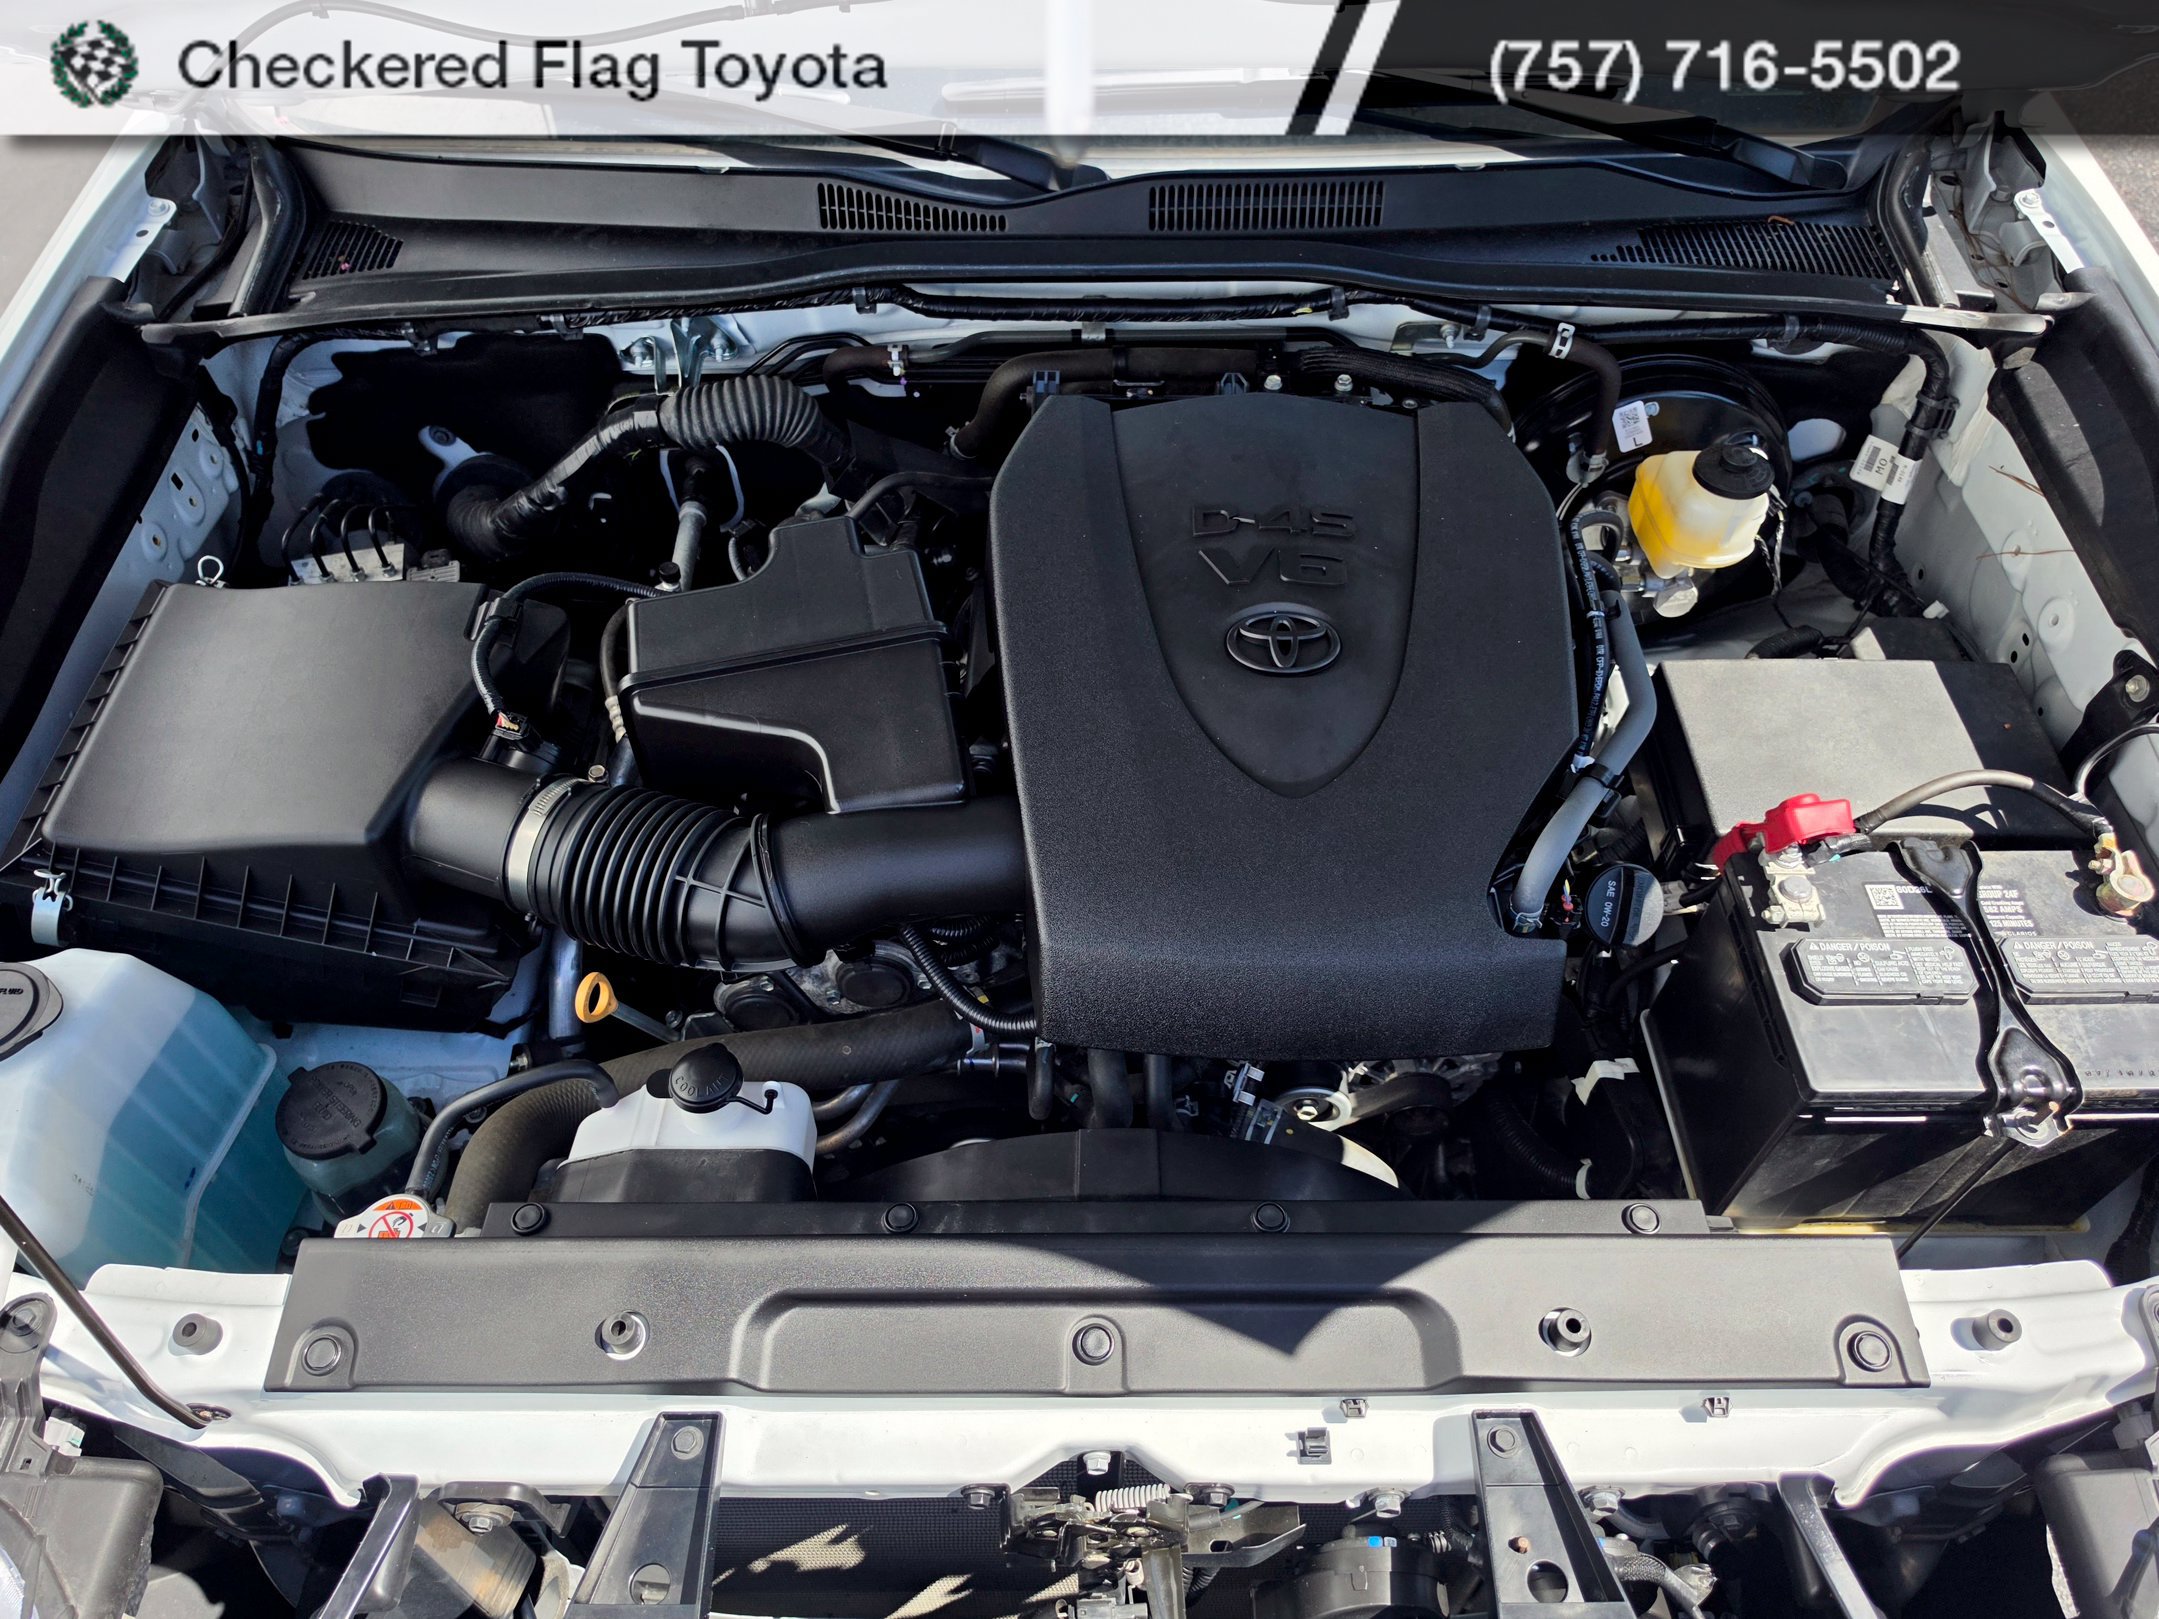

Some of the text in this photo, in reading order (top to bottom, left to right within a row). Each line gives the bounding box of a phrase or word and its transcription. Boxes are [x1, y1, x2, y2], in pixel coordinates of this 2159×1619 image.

[1192, 506, 1354, 538] D-4S
[1198, 547, 1348, 586] V6
[1601, 880, 1617, 927] SAE 0W-20
[2000, 906, 2024, 914] AMPS
[2002, 920, 2035, 928] MINUTES
[1818, 943, 1852, 951] DANGER
[1859, 943, 1891, 951] POISON
[2022, 941, 2057, 950] DANGER
[2063, 941, 2095, 950] POISON
